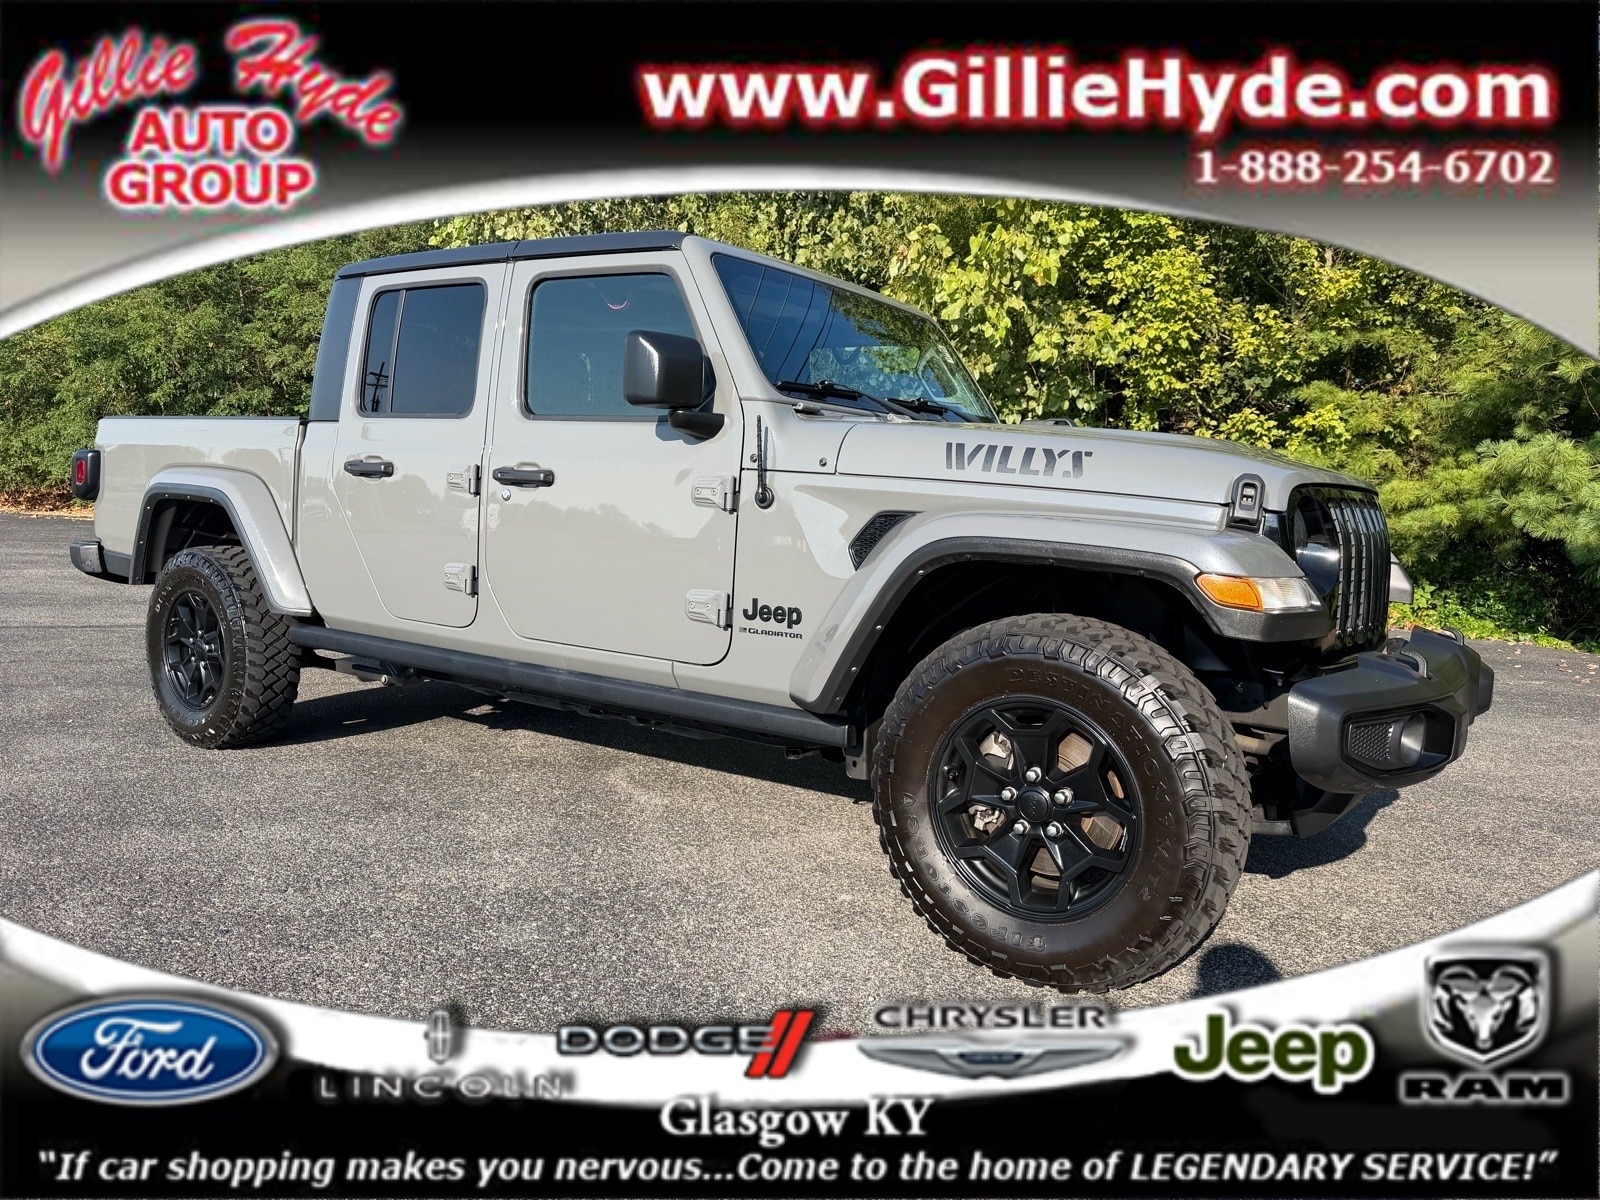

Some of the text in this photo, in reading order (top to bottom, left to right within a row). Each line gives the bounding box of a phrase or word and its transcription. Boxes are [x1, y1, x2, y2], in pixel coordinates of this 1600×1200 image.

[945, 441, 1094, 479] WILLYS
[742, 597, 803, 630] Jeep
[747, 627, 803, 640] GLADIATOR
[1006, 667, 1171, 809] DESTINATION
[905, 813, 1047, 953] Firestone
